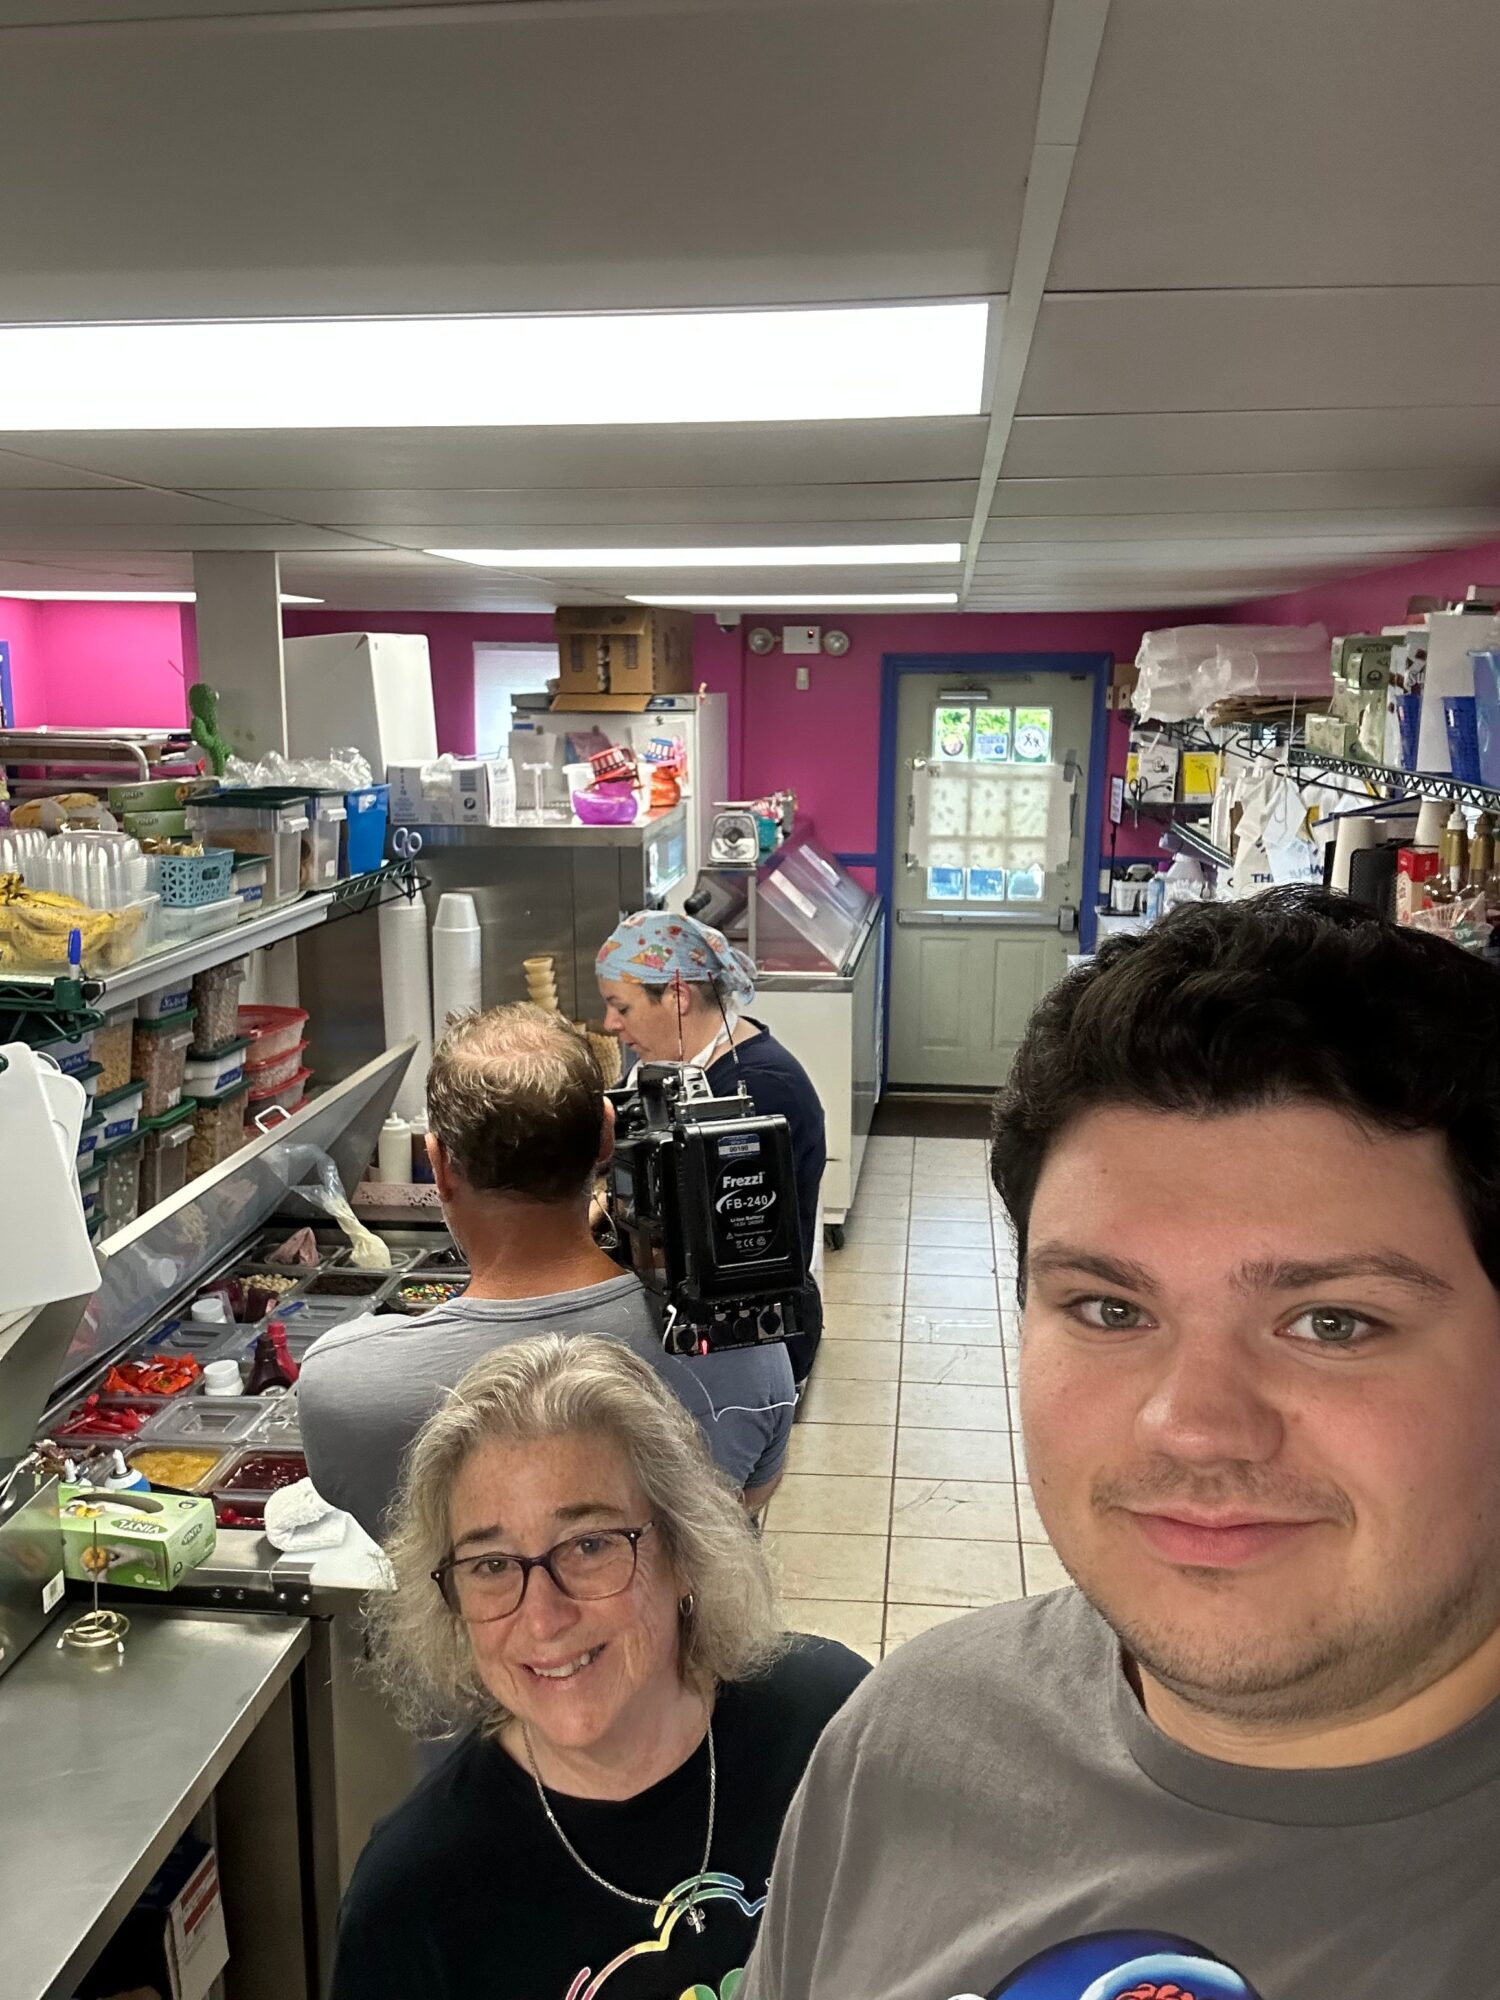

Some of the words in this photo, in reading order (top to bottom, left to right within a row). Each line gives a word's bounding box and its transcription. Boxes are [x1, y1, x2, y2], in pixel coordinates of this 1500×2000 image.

[722, 1171, 764, 1189] Frezzi
[725, 1195, 768, 1210] FB-240
[119, 1520, 161, 1534] VINYL
[182, 1523, 203, 1545] VINYL
